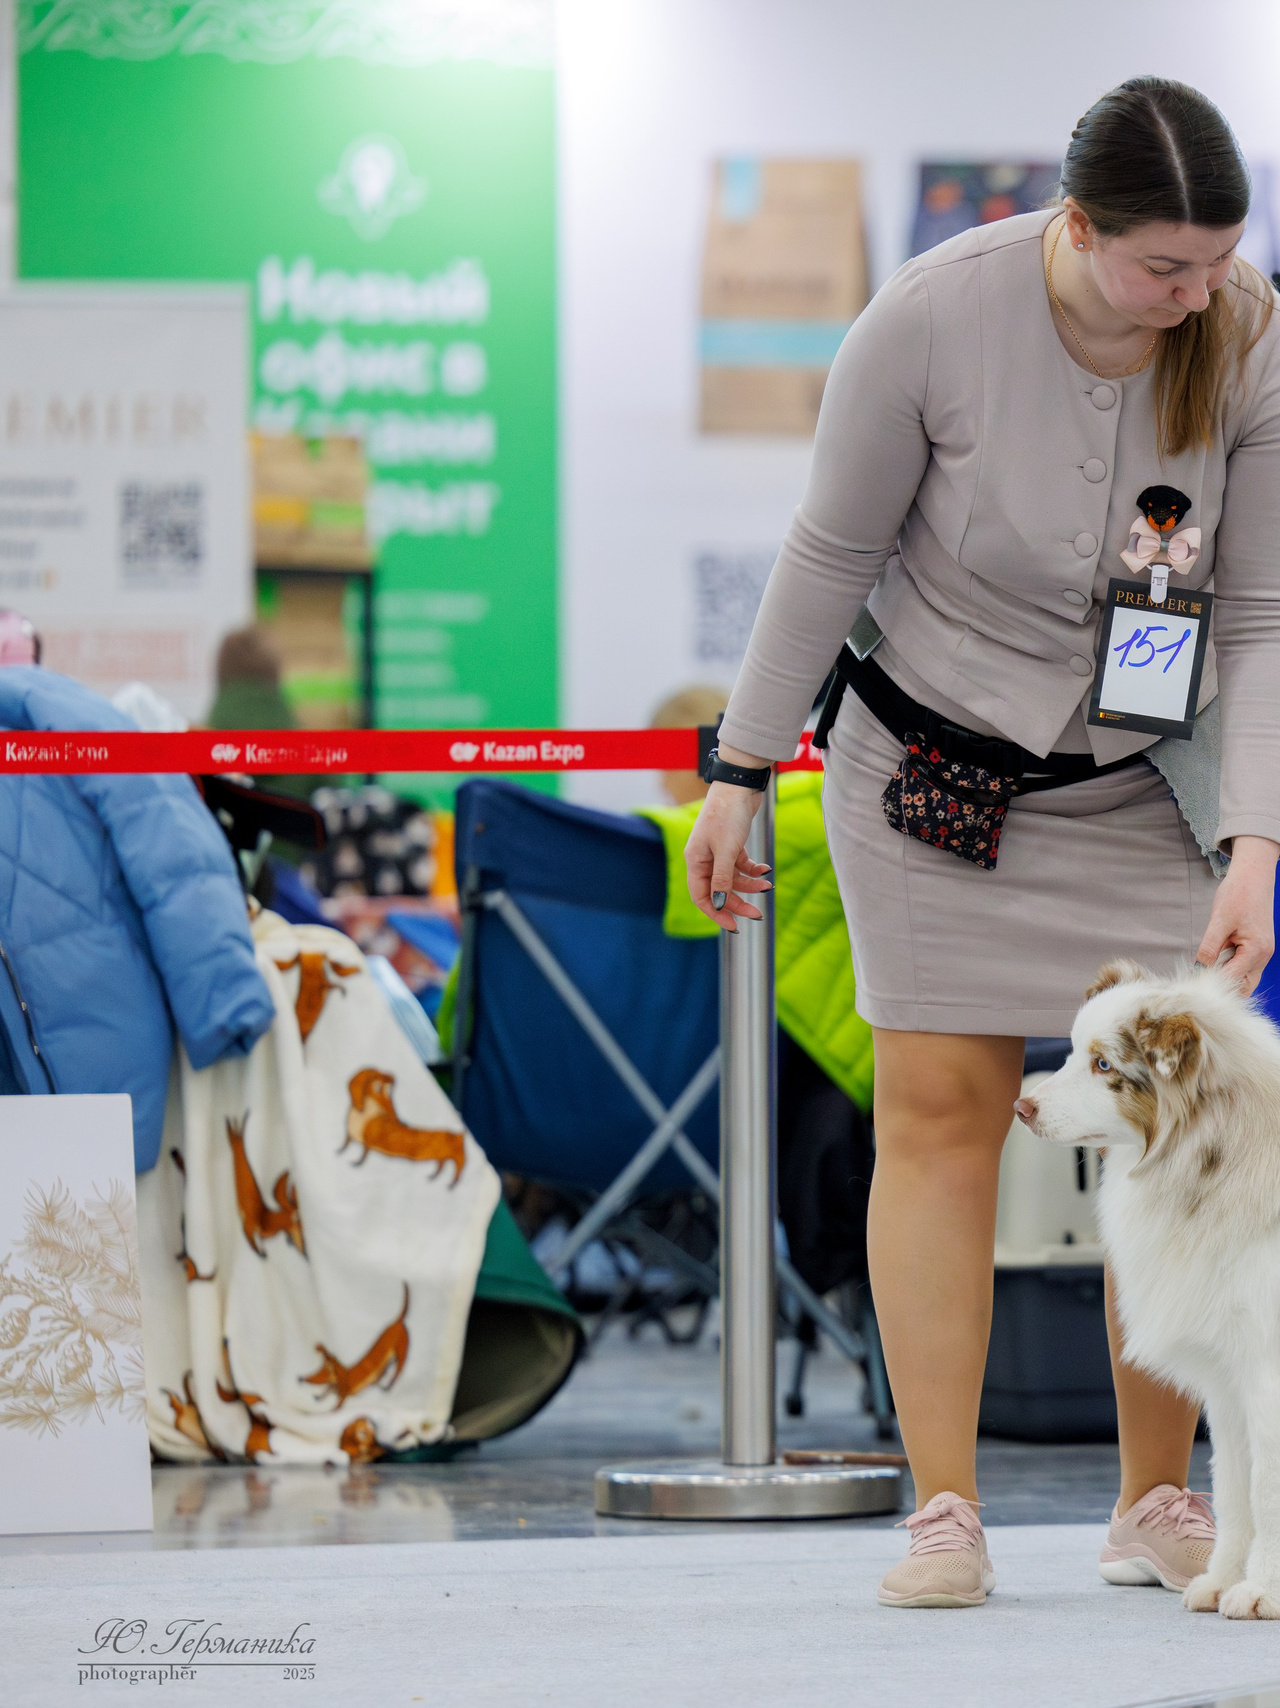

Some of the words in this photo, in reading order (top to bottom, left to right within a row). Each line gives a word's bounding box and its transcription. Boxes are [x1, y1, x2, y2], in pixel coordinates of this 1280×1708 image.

[257, 254, 489, 326] Новый
[260, 328, 436, 408] офис
[1113, 626, 1191, 673] 151
[482, 741, 539, 762] Kazan
[540, 740, 586, 765] Expo
